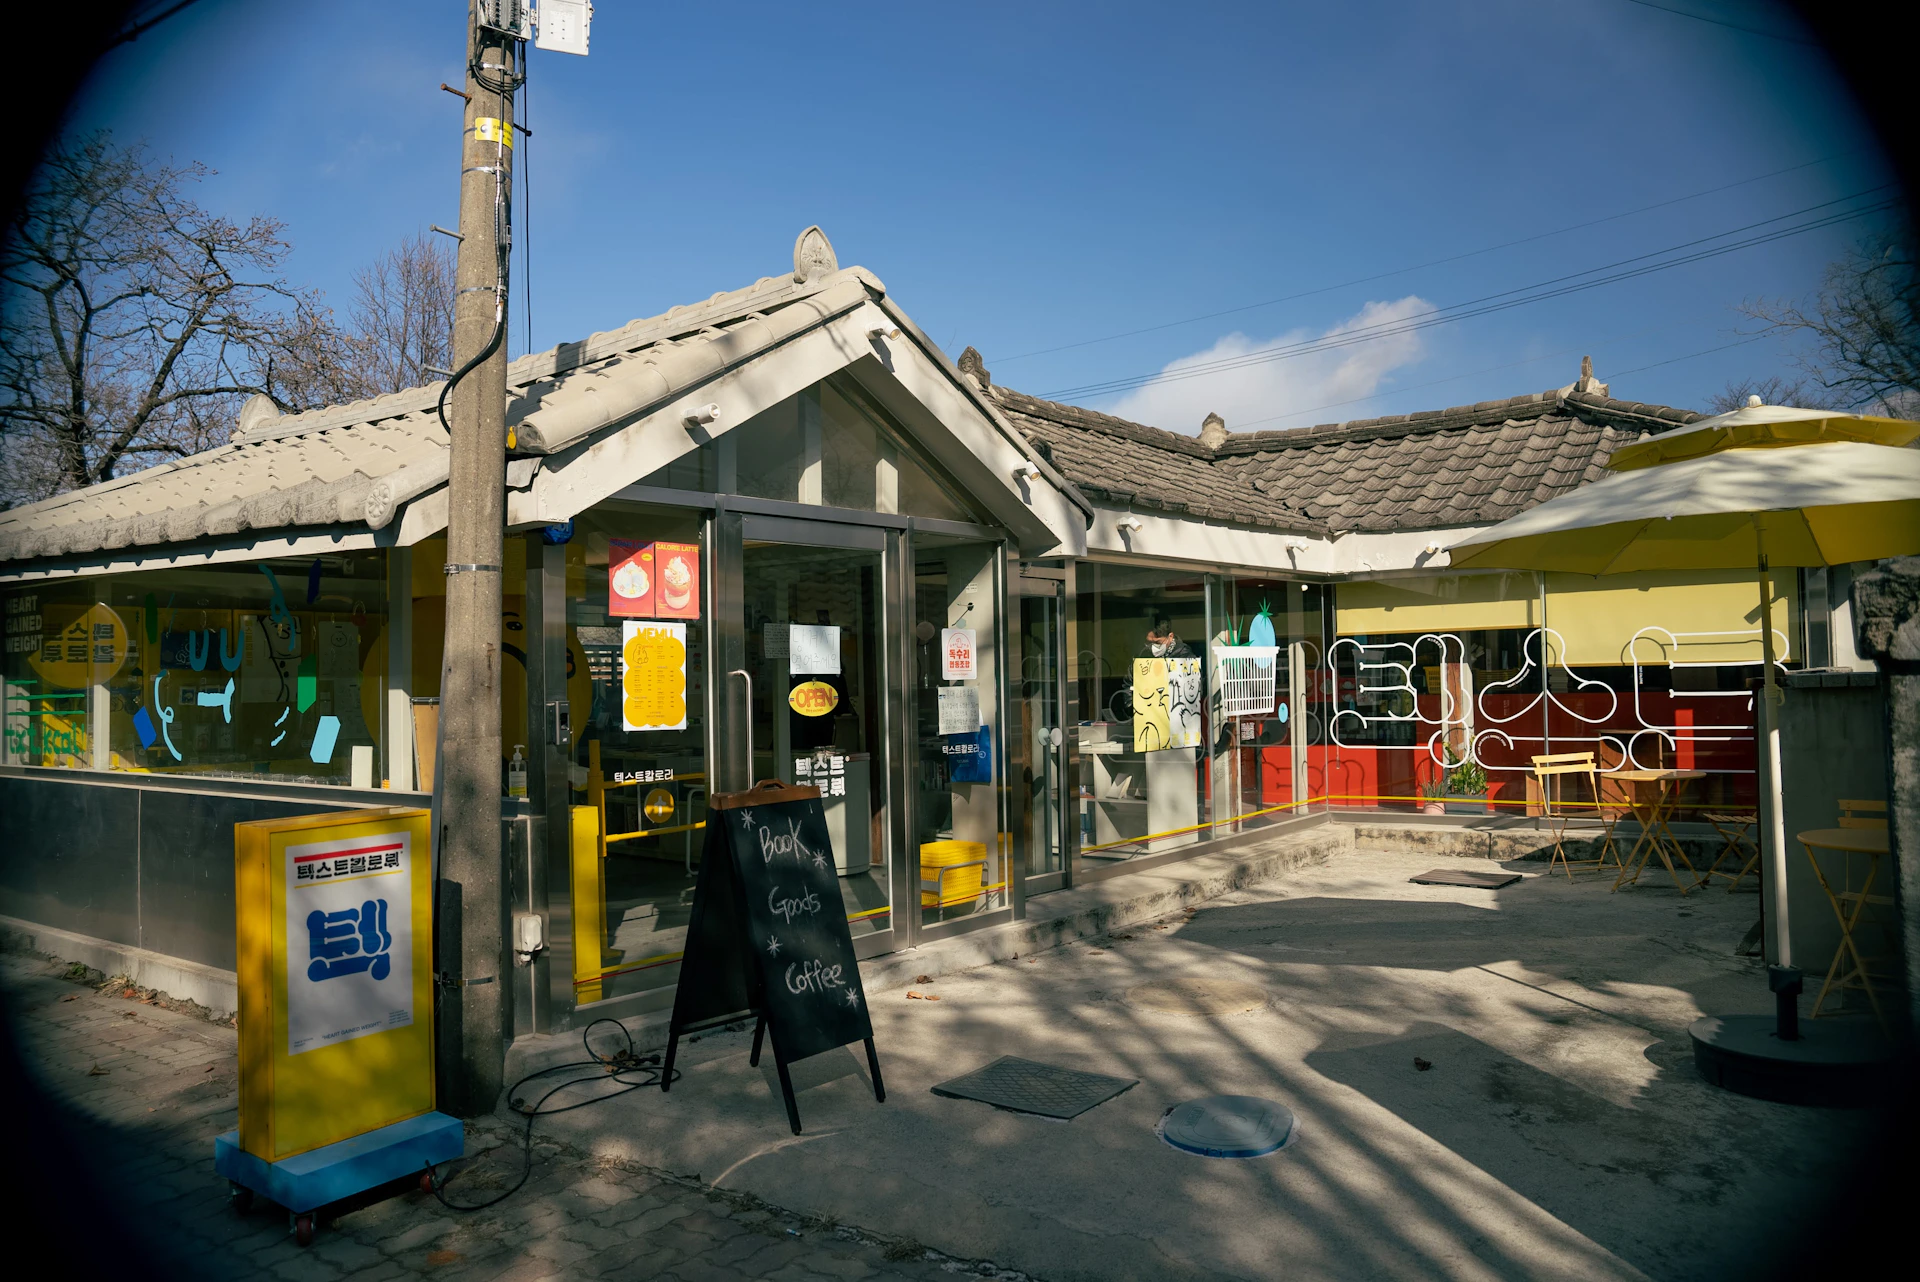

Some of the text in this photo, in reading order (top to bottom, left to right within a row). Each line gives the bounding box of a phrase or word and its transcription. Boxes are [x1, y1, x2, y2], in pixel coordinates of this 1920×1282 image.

[655, 544, 680, 552] CALORIE
[6, 595, 38, 613] HEART
[6, 615, 42, 633] GAINED
[6, 634, 43, 653] WEIGHT
[791, 652, 840, 673] 열어주세요
[949, 649, 970, 659] 독수리
[949, 660, 970, 669] 협동조합
[796, 687, 833, 708] OPEN
[942, 743, 980, 755] 텍스트칼로리
[795, 755, 845, 777] 텍스트
[614, 768, 674, 784] 텍스트칼로리
[768, 885, 822, 925] Goods
[784, 958, 846, 995] Coffee
[341, 1026, 361, 1036] GAINED
